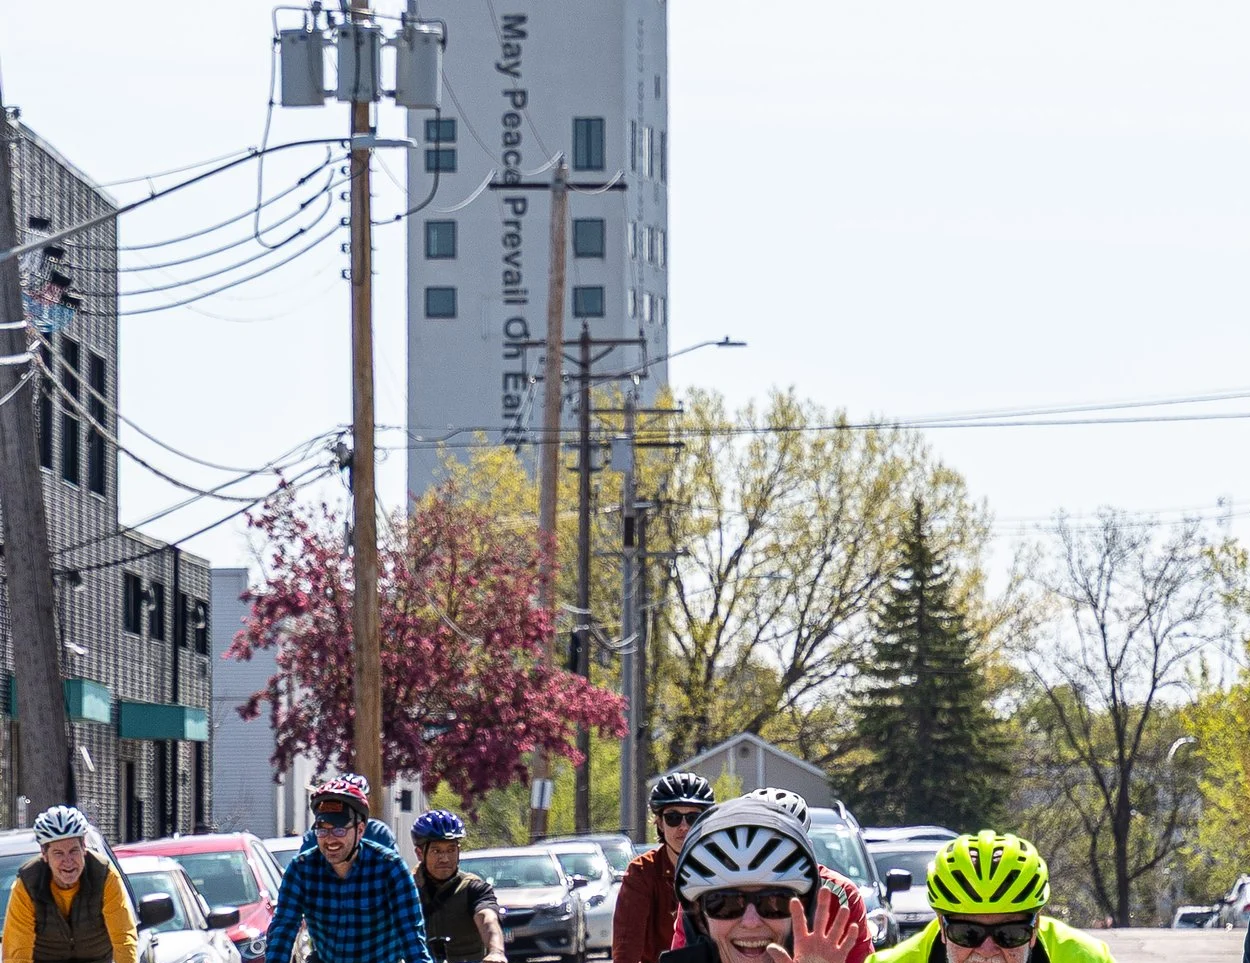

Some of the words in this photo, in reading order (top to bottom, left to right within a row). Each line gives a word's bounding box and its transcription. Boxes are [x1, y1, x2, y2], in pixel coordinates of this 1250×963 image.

[495, 14, 528, 79] May
[502, 89, 528, 187] Peace
[502, 197, 528, 305] Prevail
[502, 317, 529, 360] On
